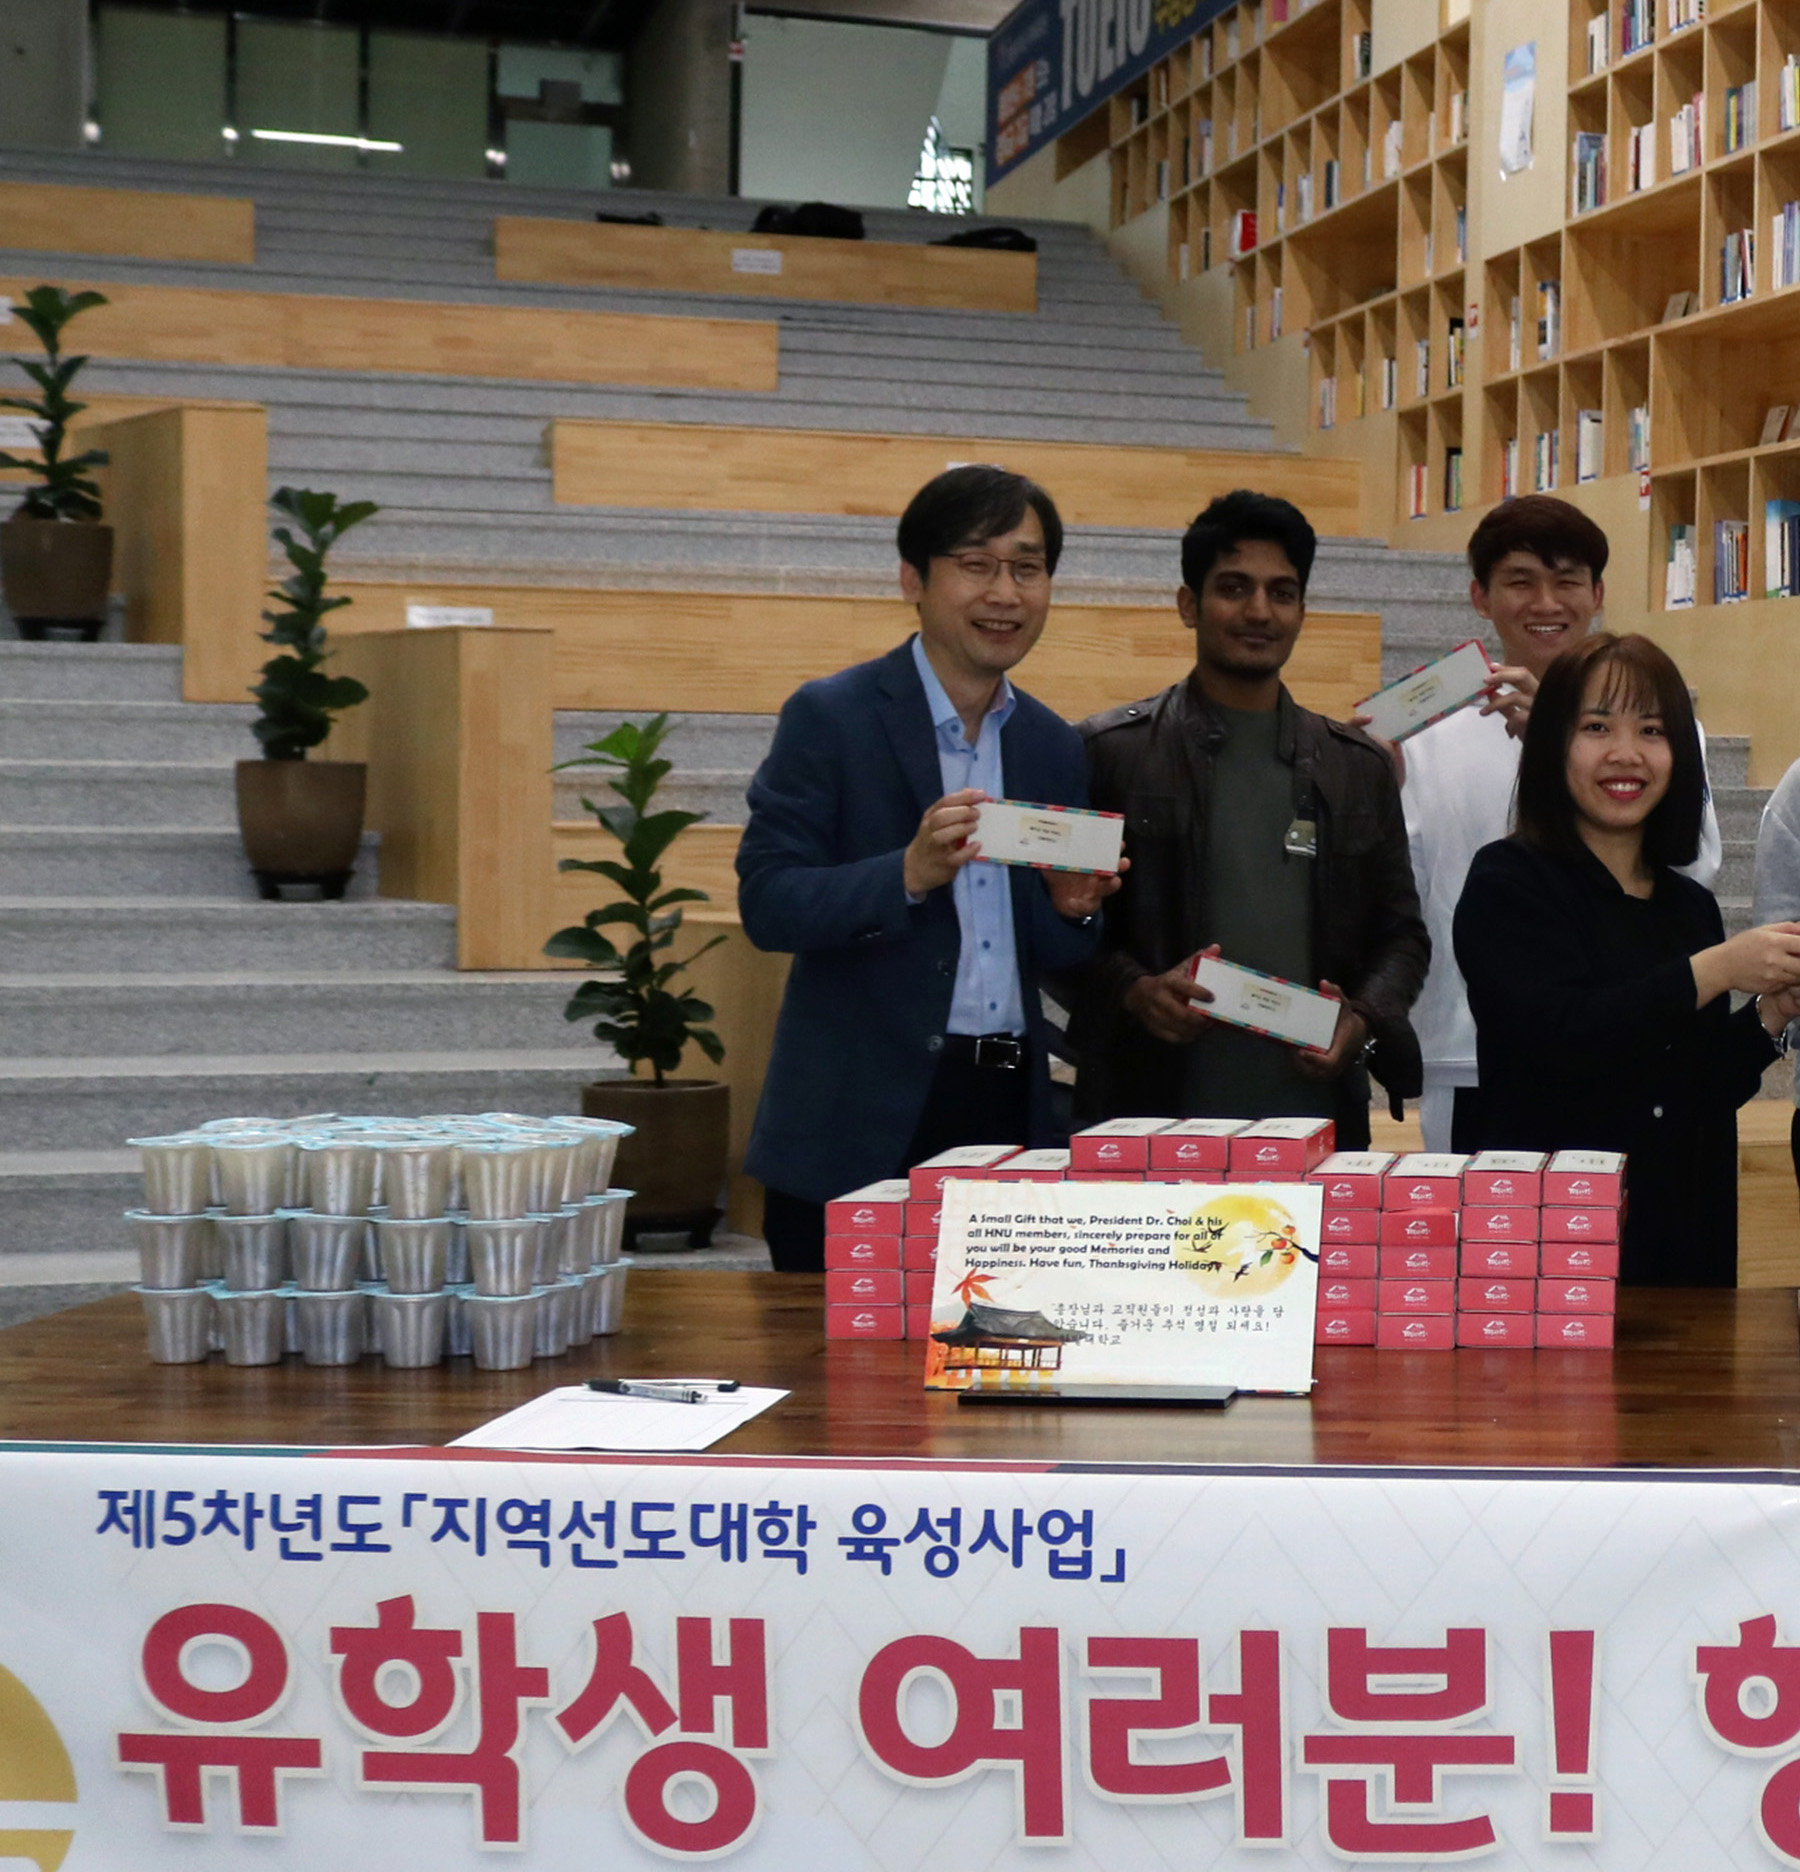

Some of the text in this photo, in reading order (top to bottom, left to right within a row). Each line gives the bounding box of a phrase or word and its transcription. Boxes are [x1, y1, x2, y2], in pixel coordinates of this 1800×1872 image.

[969, 1214, 977, 1223] A
[981, 1214, 1012, 1223] Small
[1014, 1214, 1036, 1223] Gift
[1039, 1215, 1063, 1224] that
[1090, 1215, 1142, 1225] President
[1146, 1216, 1163, 1225] Dr.
[1167, 1216, 1192, 1226] Choi
[967, 1228, 981, 1238] all
[984, 1229, 1012, 1238] HNU
[1015, 1229, 1070, 1239] members,
[1074, 1230, 1122, 1241] sincerely
[1126, 1232, 1171, 1241] prepare
[1174, 1231, 1190, 1240] for
[1193, 1231, 1208, 1240] all
[966, 1243, 1170, 1255] you will be your good Memories and
[965, 1258, 1026, 1269] Happiness.
[1029, 1258, 1059, 1267] Have
[1063, 1259, 1085, 1268] fun,
[1089, 1259, 1165, 1271] Thanksgiving
[838, 1503, 1125, 1583] 육성사업」
[118, 1596, 769, 1852] 유학생
[859, 1626, 1595, 1854] 여러분!
